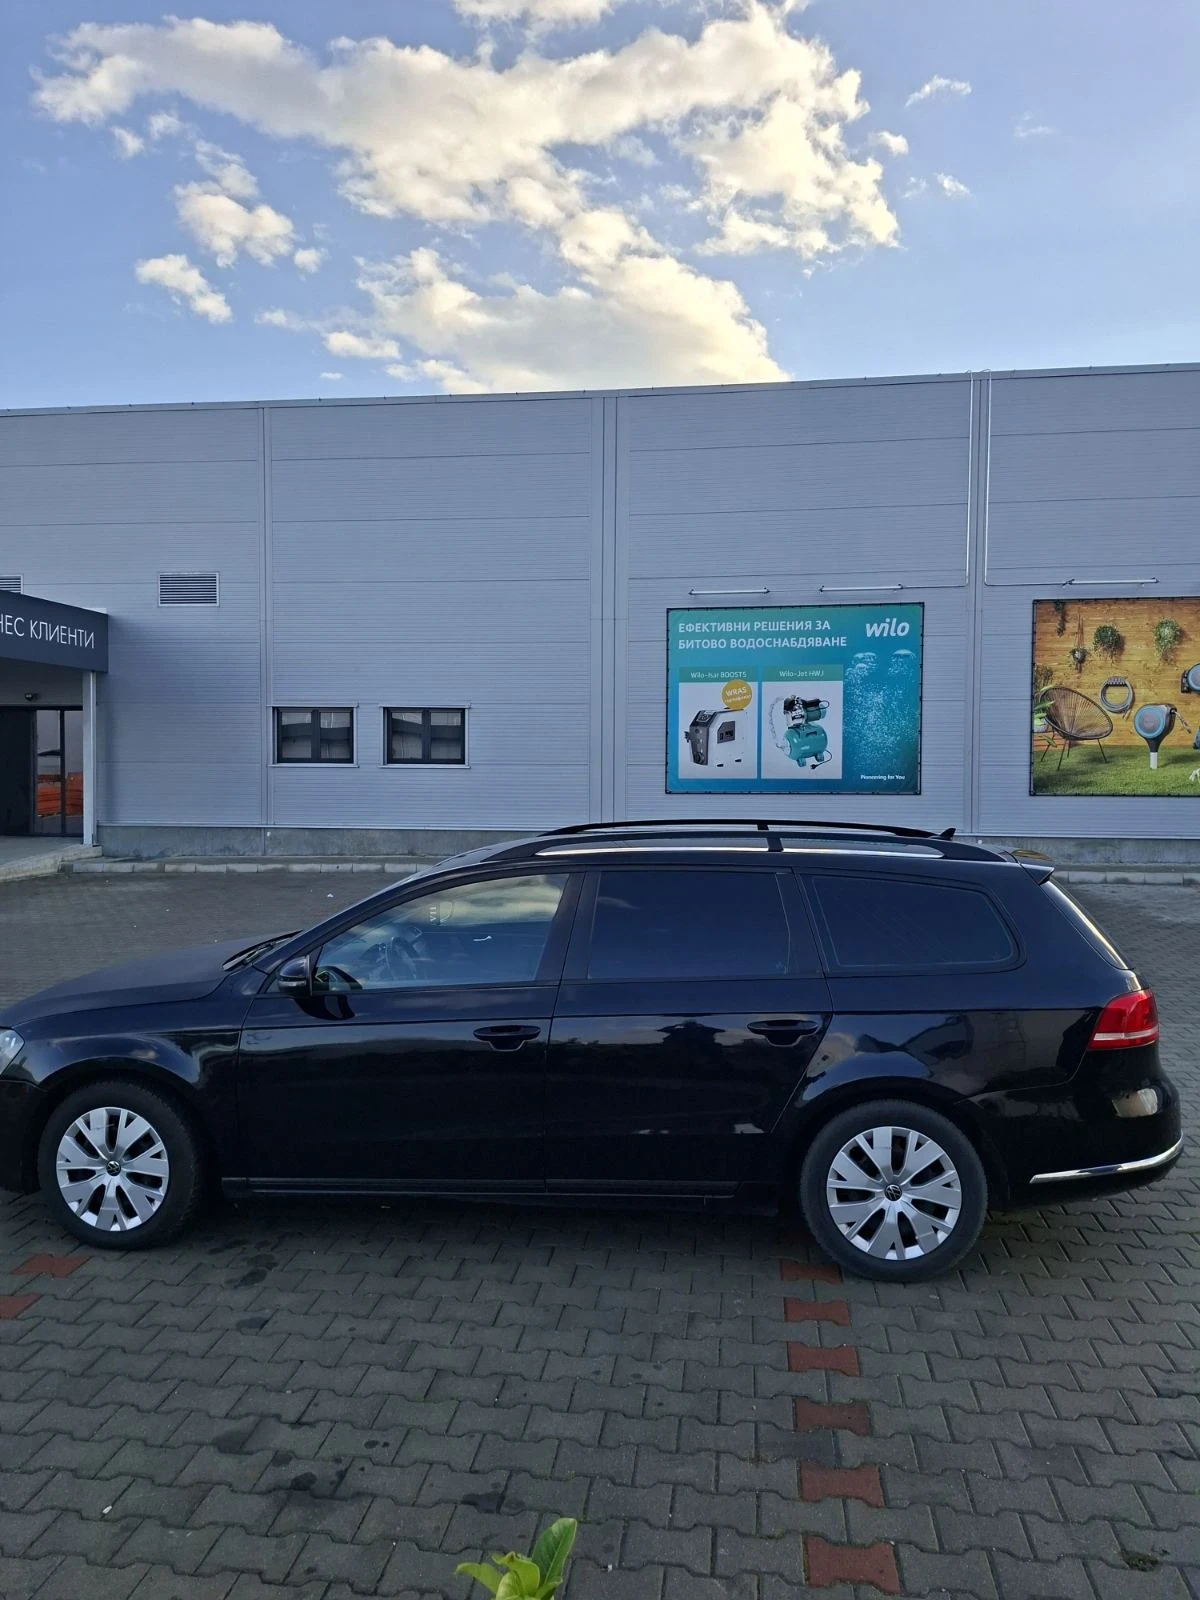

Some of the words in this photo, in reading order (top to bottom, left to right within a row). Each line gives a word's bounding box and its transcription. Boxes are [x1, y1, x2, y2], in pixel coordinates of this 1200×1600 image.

[678, 622, 751, 633] ЕФЕКТИВНИ
[753, 620, 812, 632] РЕШЕНИЯ
[815, 620, 831, 630] ЗА
[865, 617, 910, 638] wilo
[30, 619, 95, 649] КЛИЕНТИ
[678, 639, 727, 649] БИТОВО
[730, 636, 847, 650] ВОДОСНАБДЯВАНЕ
[725, 686, 747, 697] WRAS
